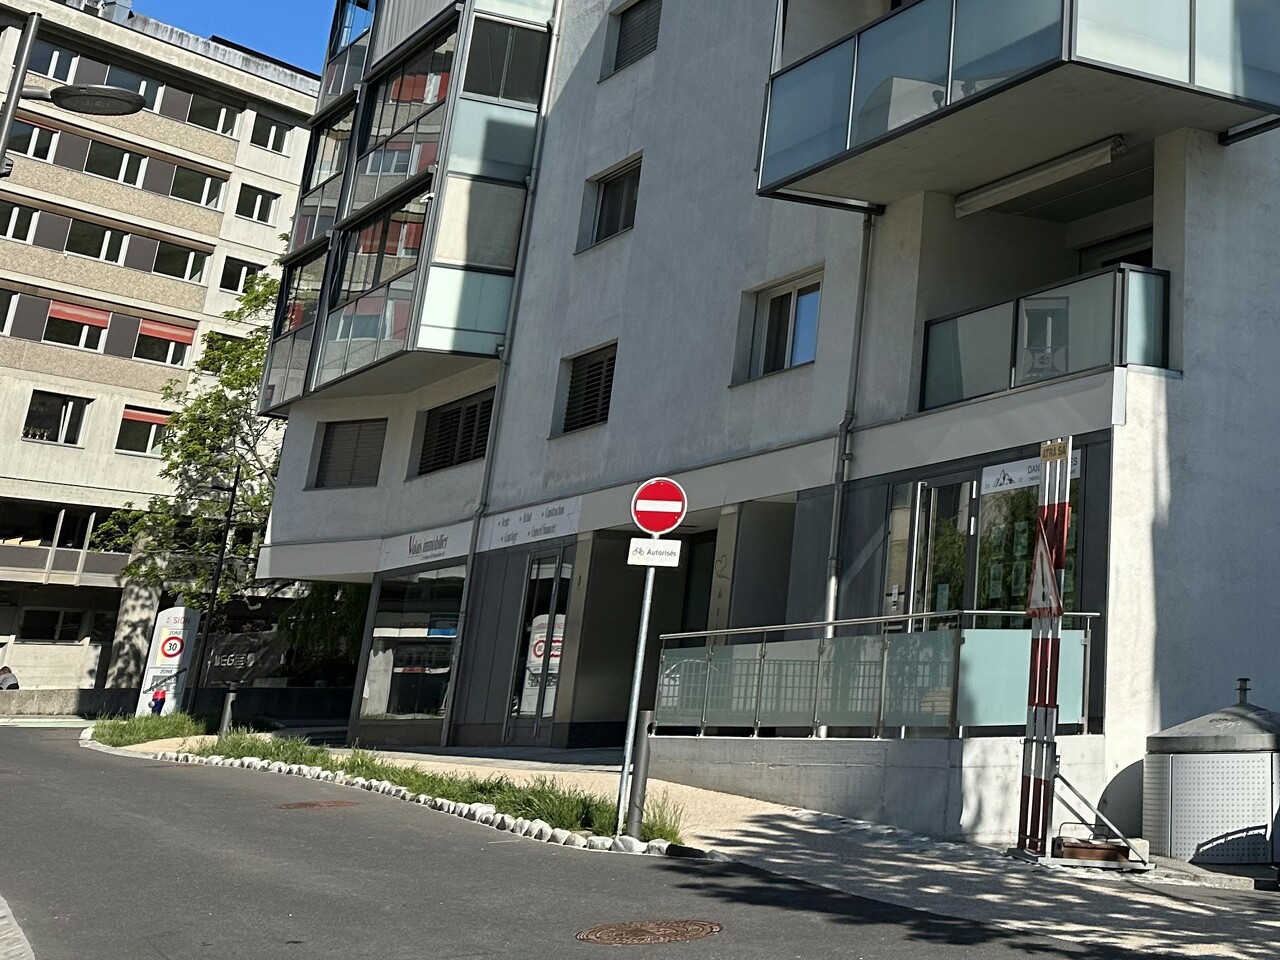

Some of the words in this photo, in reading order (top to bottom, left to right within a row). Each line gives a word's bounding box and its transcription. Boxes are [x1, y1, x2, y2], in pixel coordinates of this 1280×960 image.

[1057, 444, 1067, 456] SA
[646, 548, 676, 557] Autorisés
[173, 616, 191, 624] SION
[167, 642, 177, 651] 30
